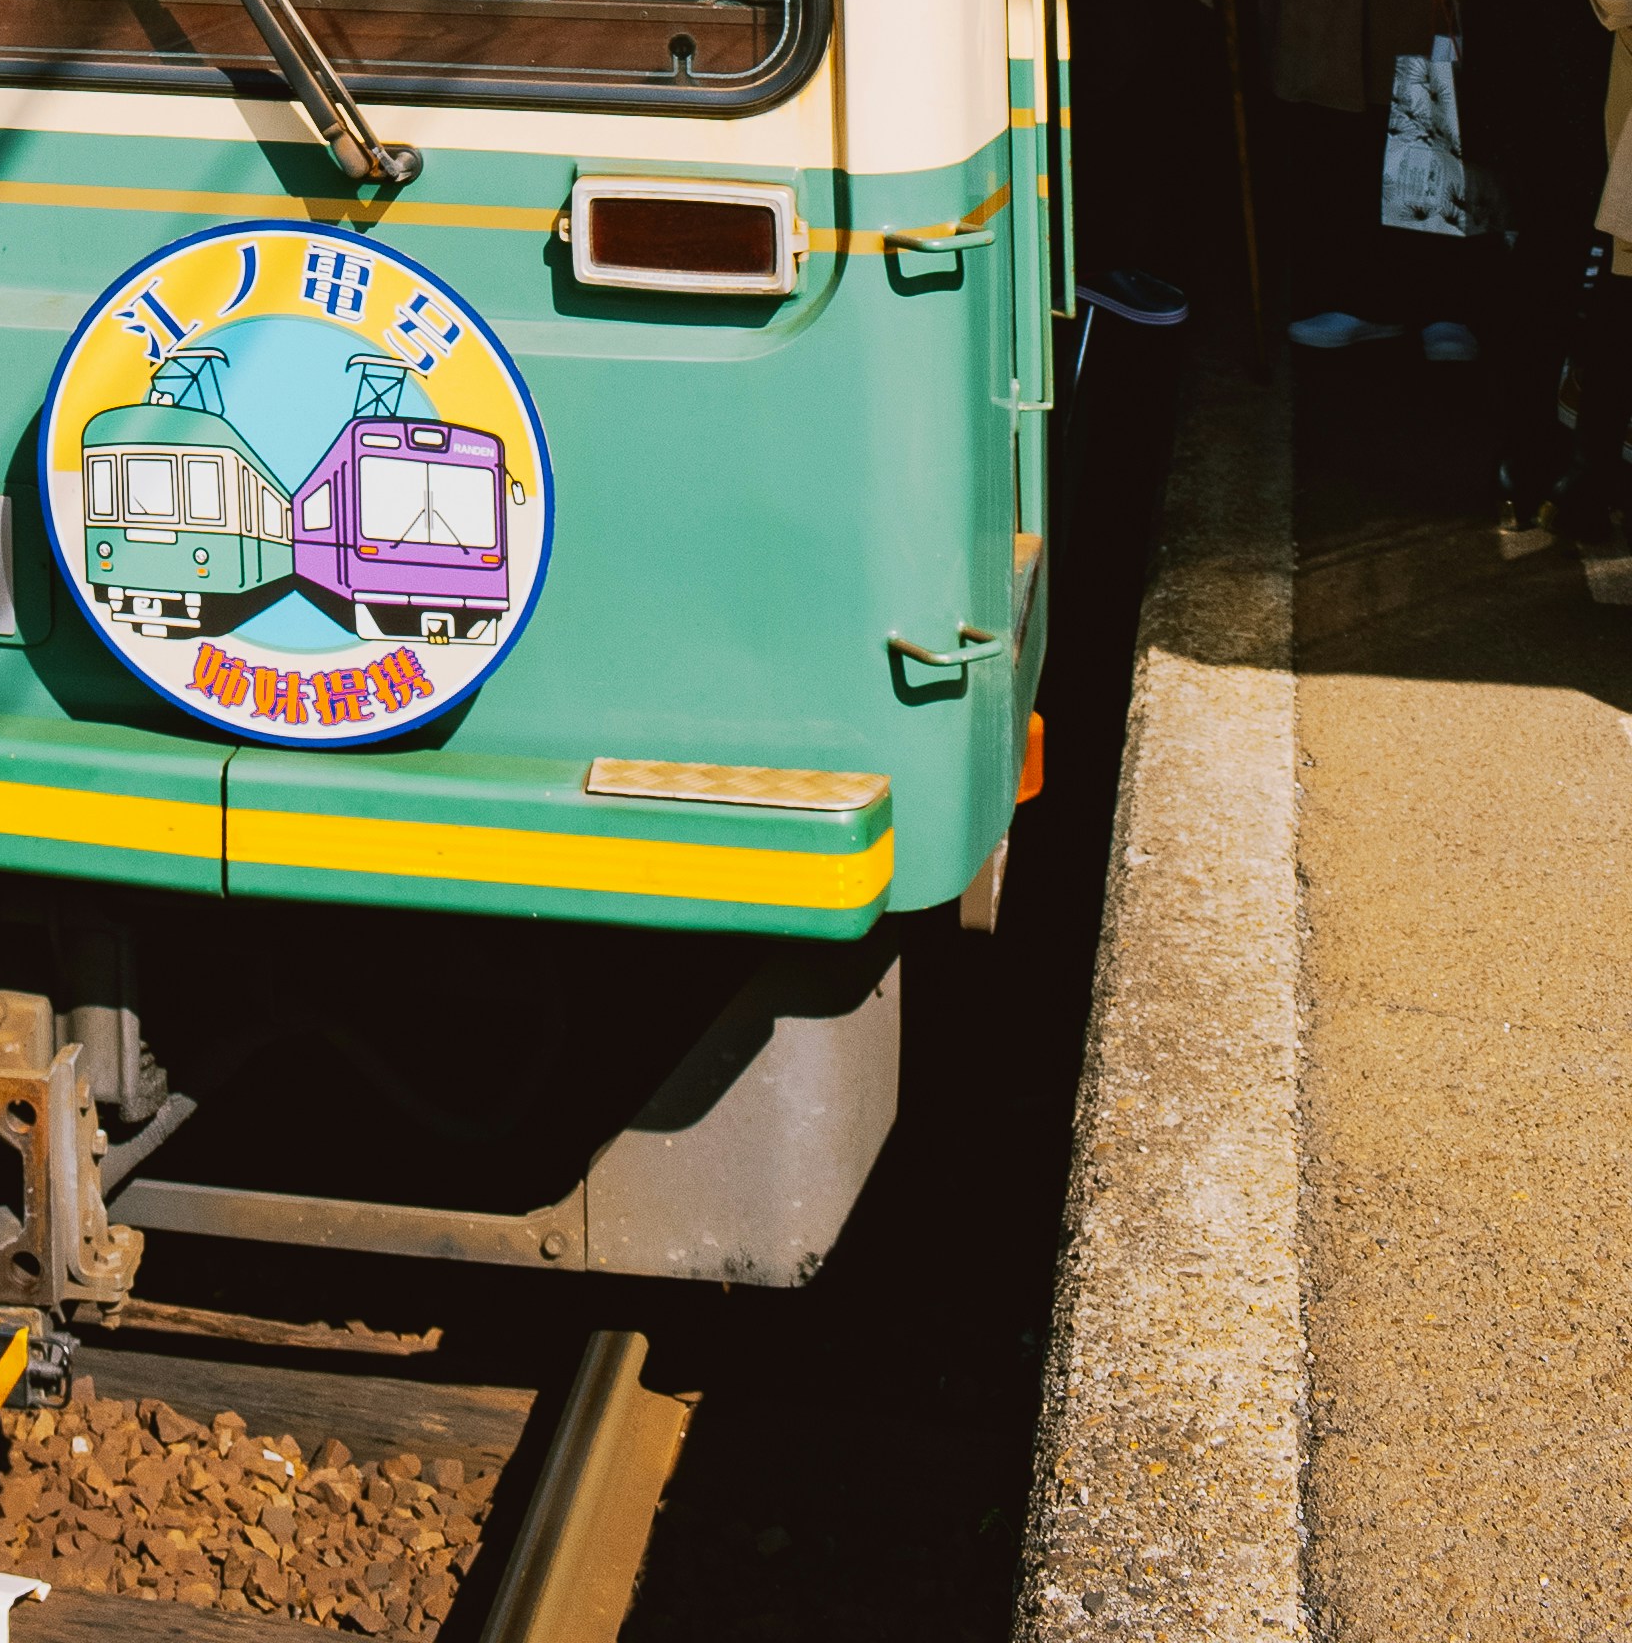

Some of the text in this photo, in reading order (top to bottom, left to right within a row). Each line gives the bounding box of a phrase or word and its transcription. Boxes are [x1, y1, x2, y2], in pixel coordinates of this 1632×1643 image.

[113, 243, 463, 376] 江ノ電号
[453, 442, 495, 458] RANDEN
[185, 641, 436, 727] 姉妹提携
